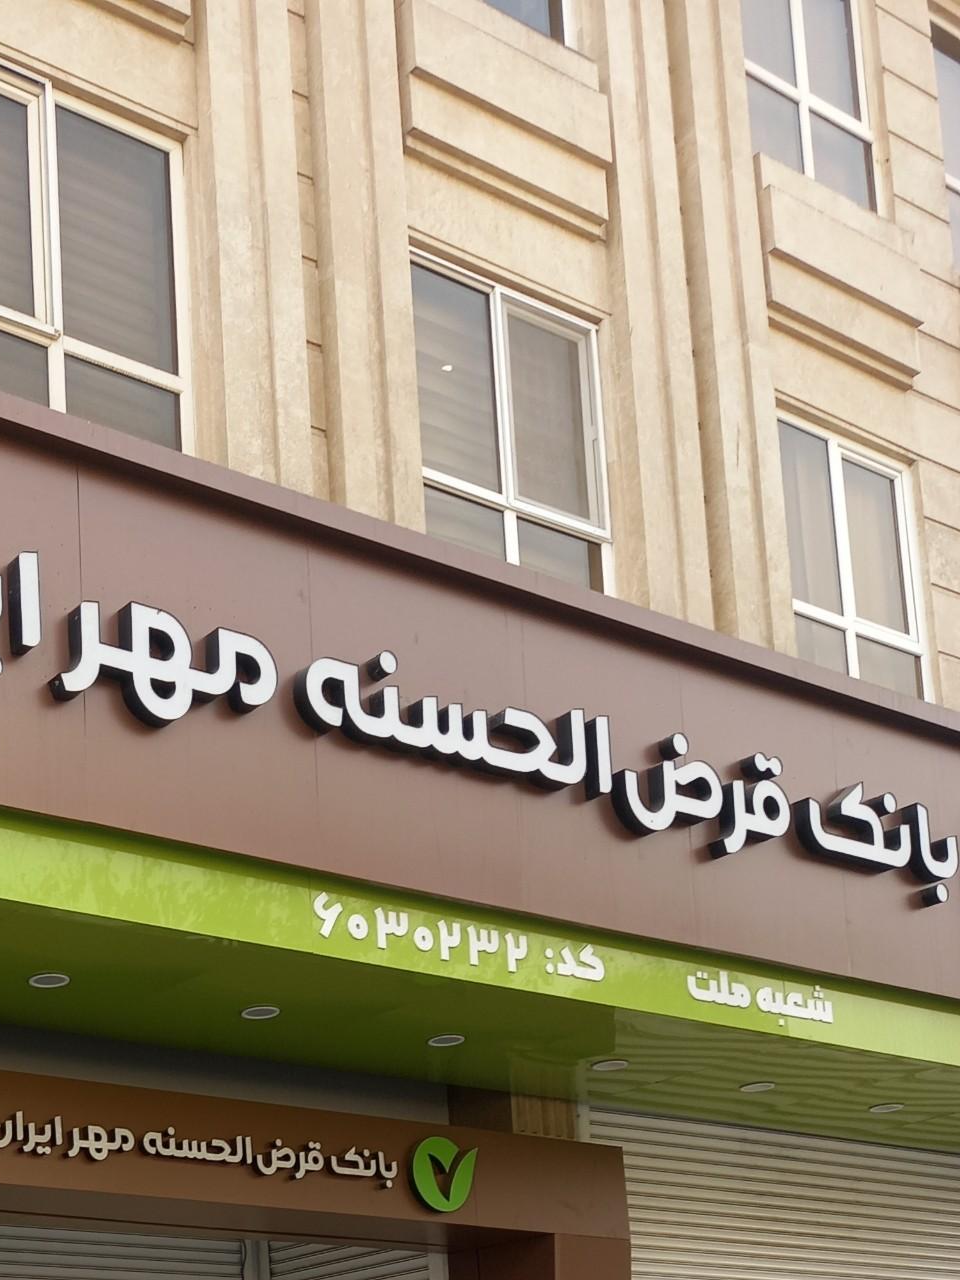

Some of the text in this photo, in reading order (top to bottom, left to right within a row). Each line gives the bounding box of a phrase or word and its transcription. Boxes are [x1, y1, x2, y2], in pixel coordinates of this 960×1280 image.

[50, 600, 279, 726] مهر
[297, 650, 613, 797] الحسنه
[616, 732, 791, 856] قرض
[797, 781, 959, 904] بانک
[312, 891, 529, 974] ۶۰۳۰۲۳۲
[686, 970, 834, 1027] شعبه ملت
[67, 1124, 135, 1161] مهر
[142, 1126, 253, 1165] الحسنه
[256, 1138, 325, 1180] قرض
[330, 1146, 398, 1189] بانک
